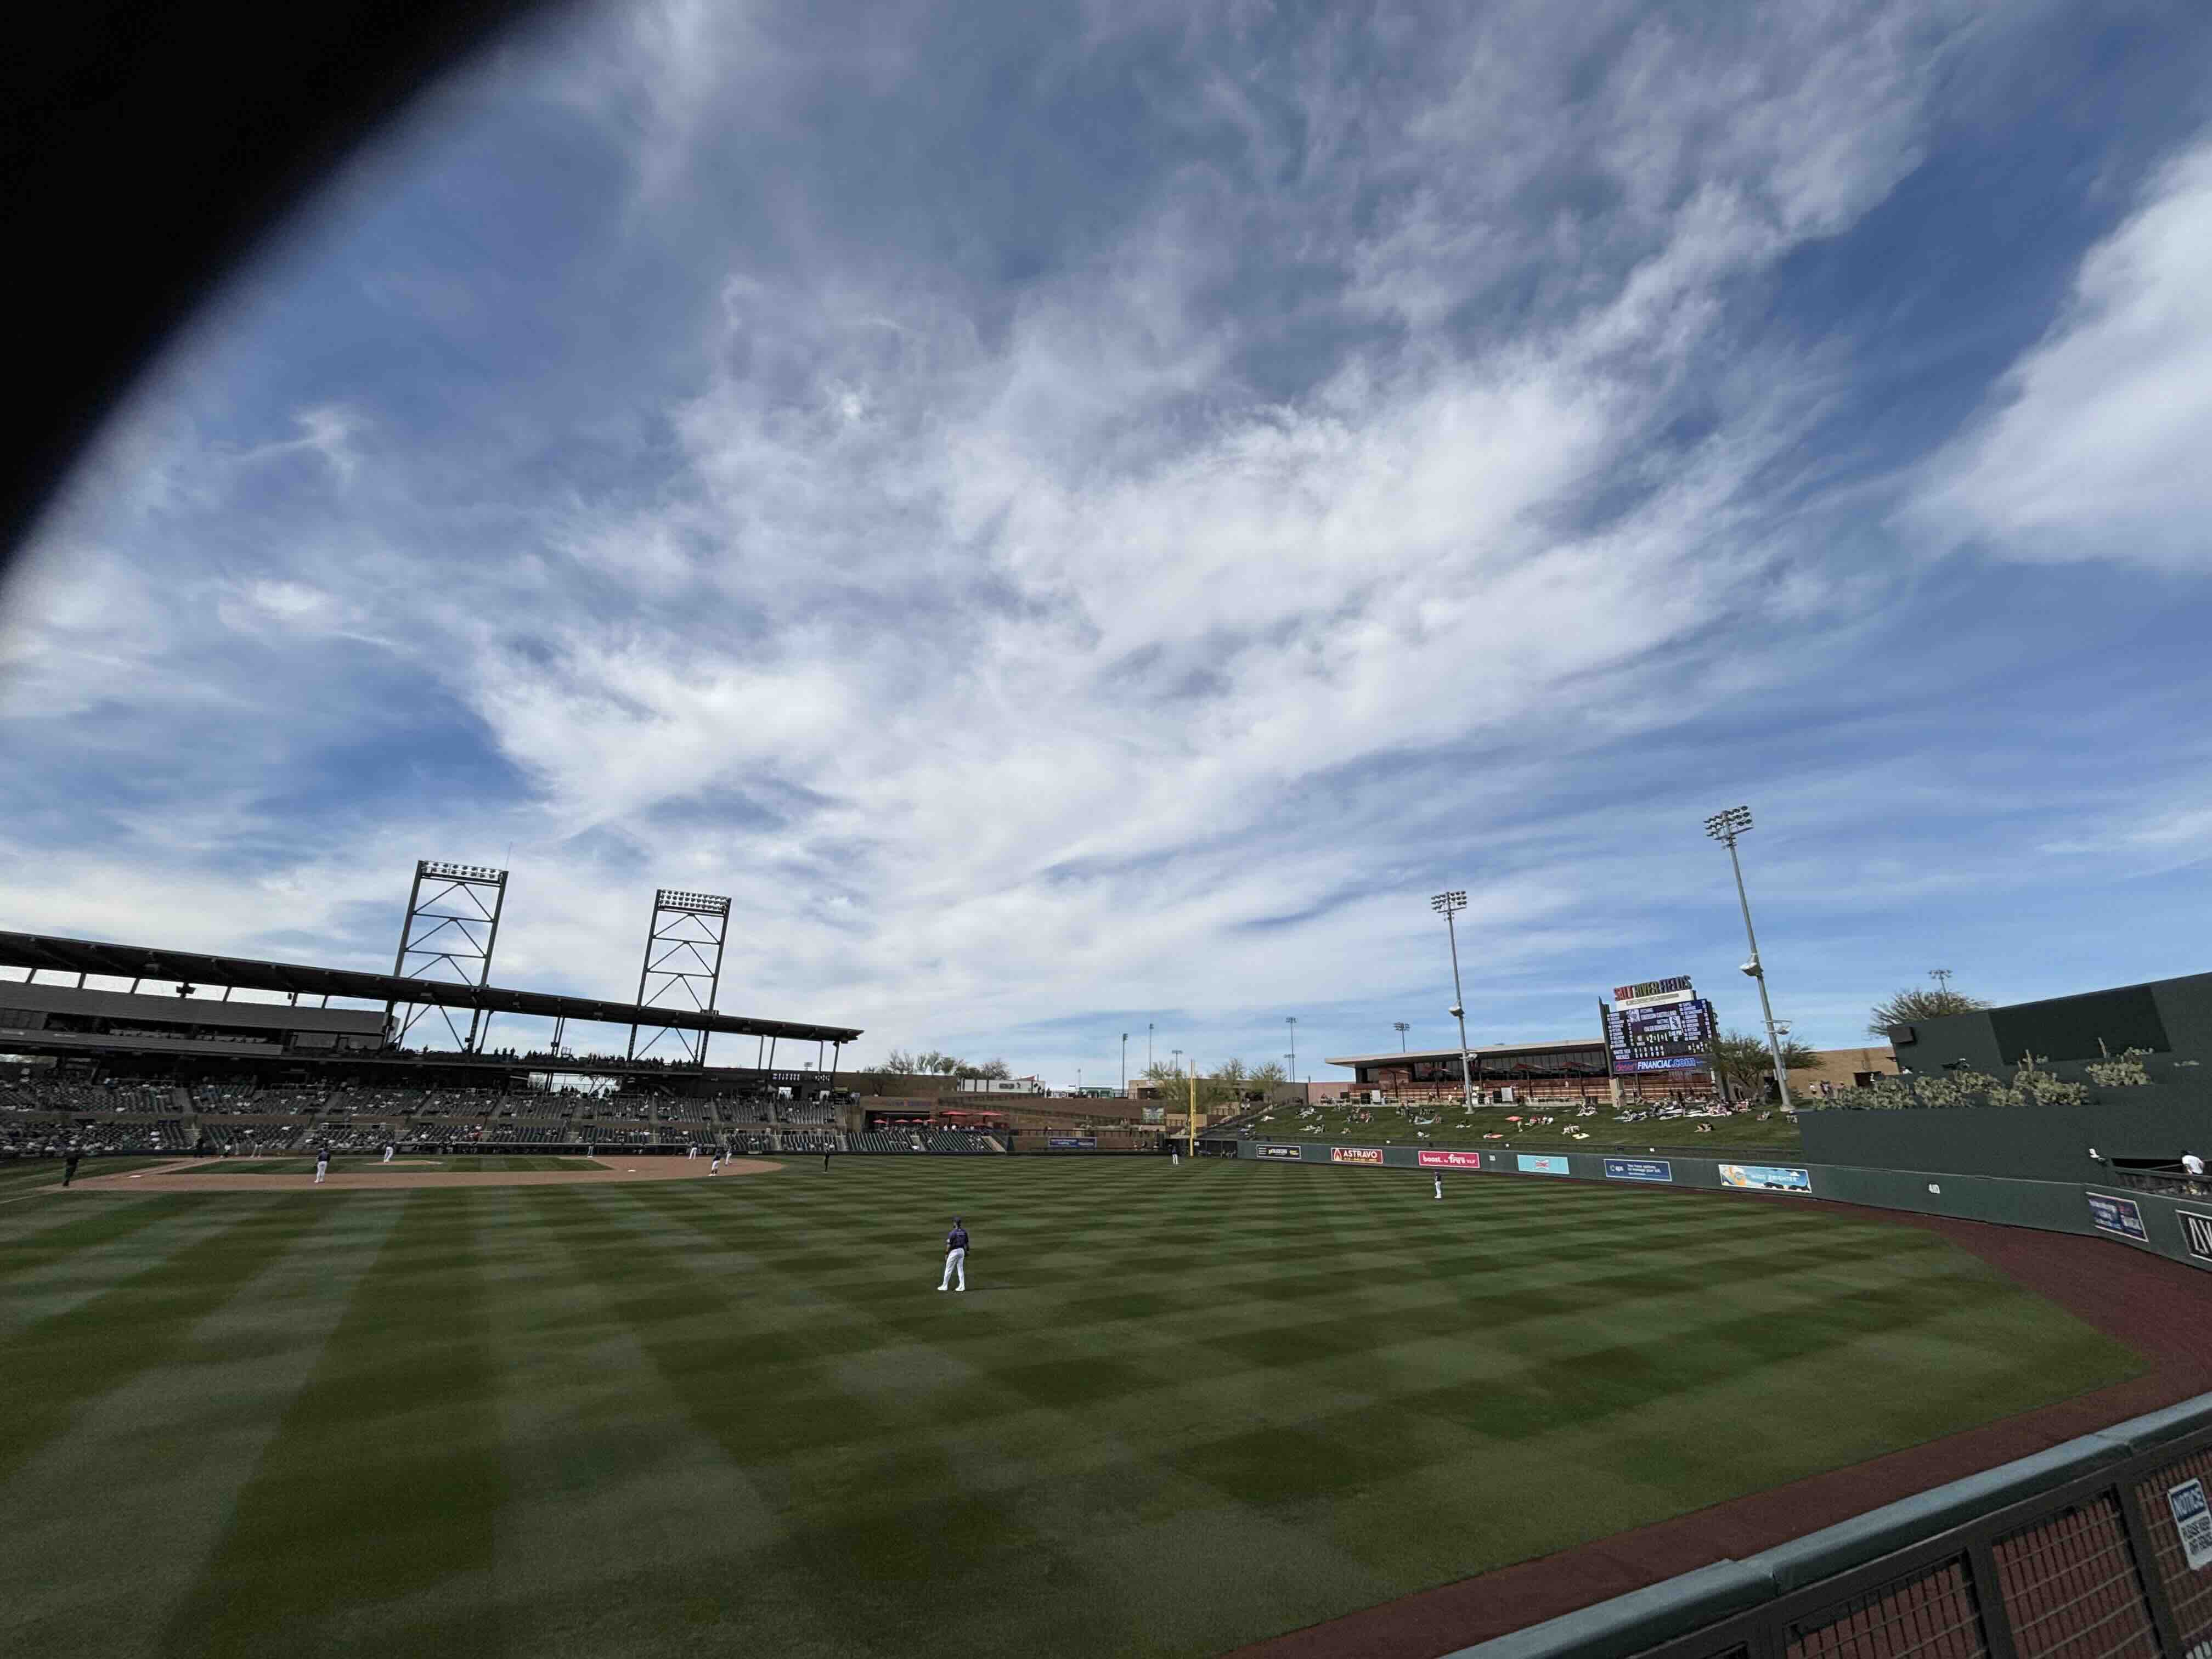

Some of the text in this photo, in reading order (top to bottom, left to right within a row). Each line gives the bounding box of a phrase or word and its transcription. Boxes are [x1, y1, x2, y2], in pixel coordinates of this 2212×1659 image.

[1633, 981, 1660, 998] RIVER
[1659, 975, 1692, 993] FIELDS
[1343, 1150, 1378, 1159] ASTRAVO
